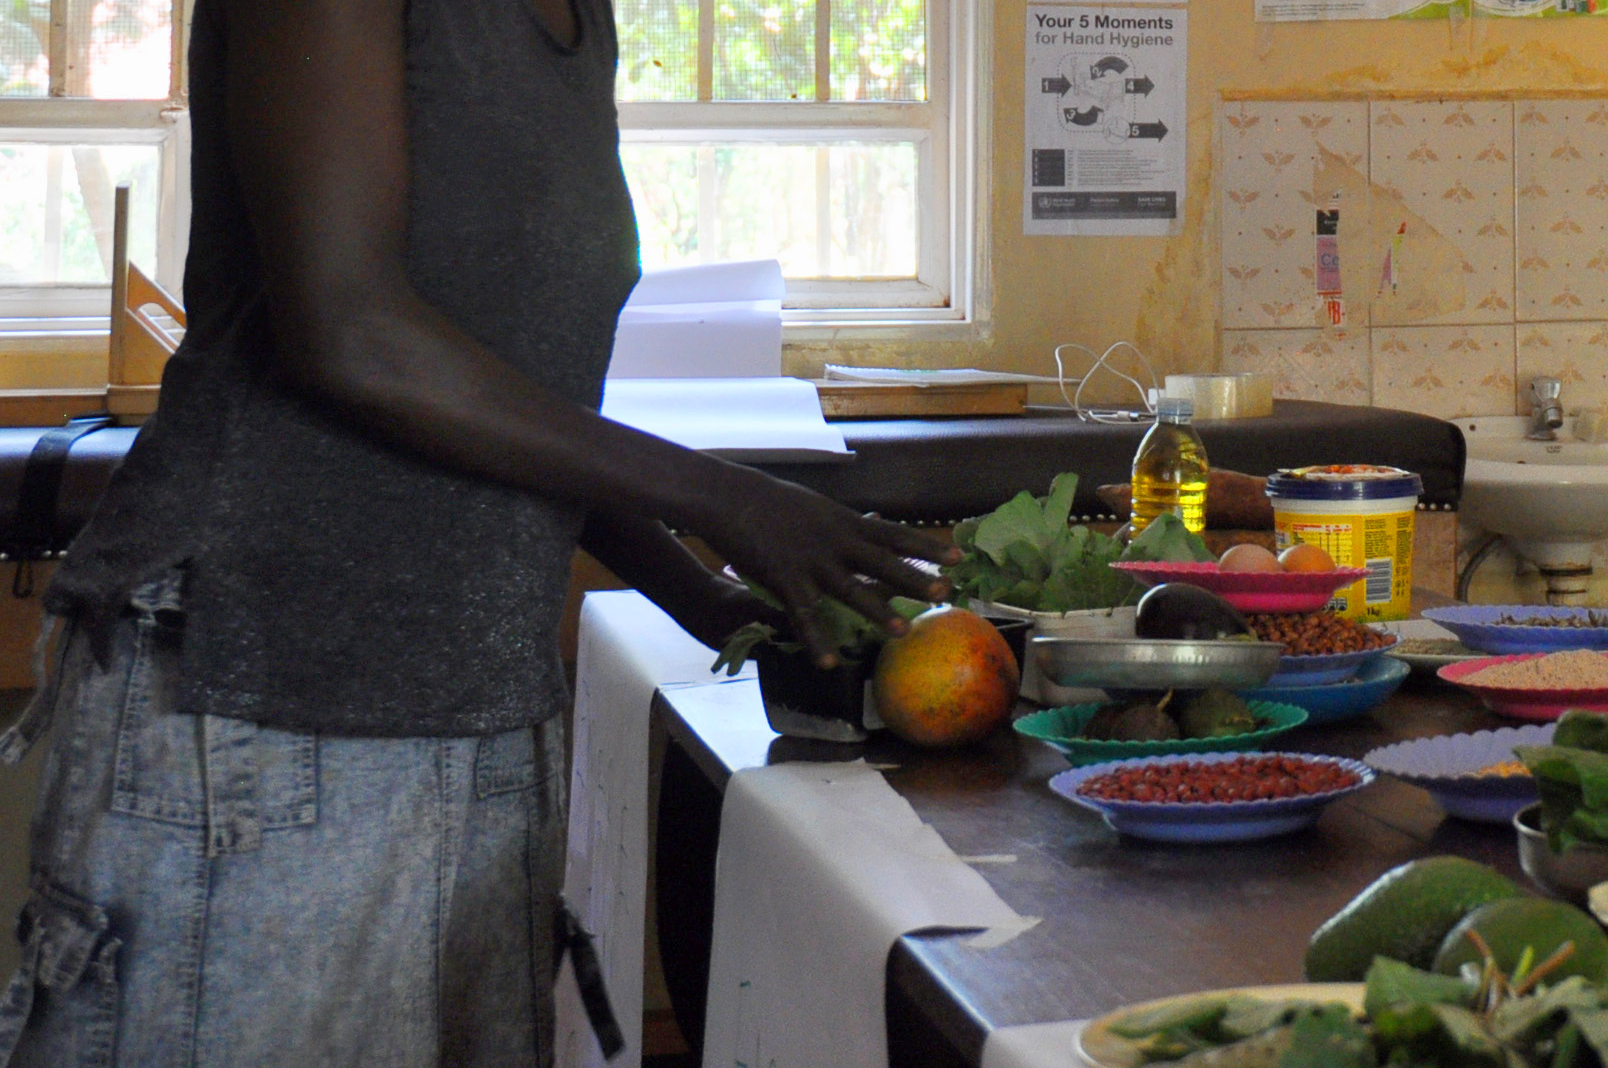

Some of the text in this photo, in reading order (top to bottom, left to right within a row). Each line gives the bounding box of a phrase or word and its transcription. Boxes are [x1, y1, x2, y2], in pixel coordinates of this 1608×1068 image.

[1035, 13, 1174, 30] Your 5 Moments
[1035, 32, 1174, 49] for Hand Hygiene
[1043, 79, 1135, 91] 1 4
[1131, 125, 1140, 137] 5
